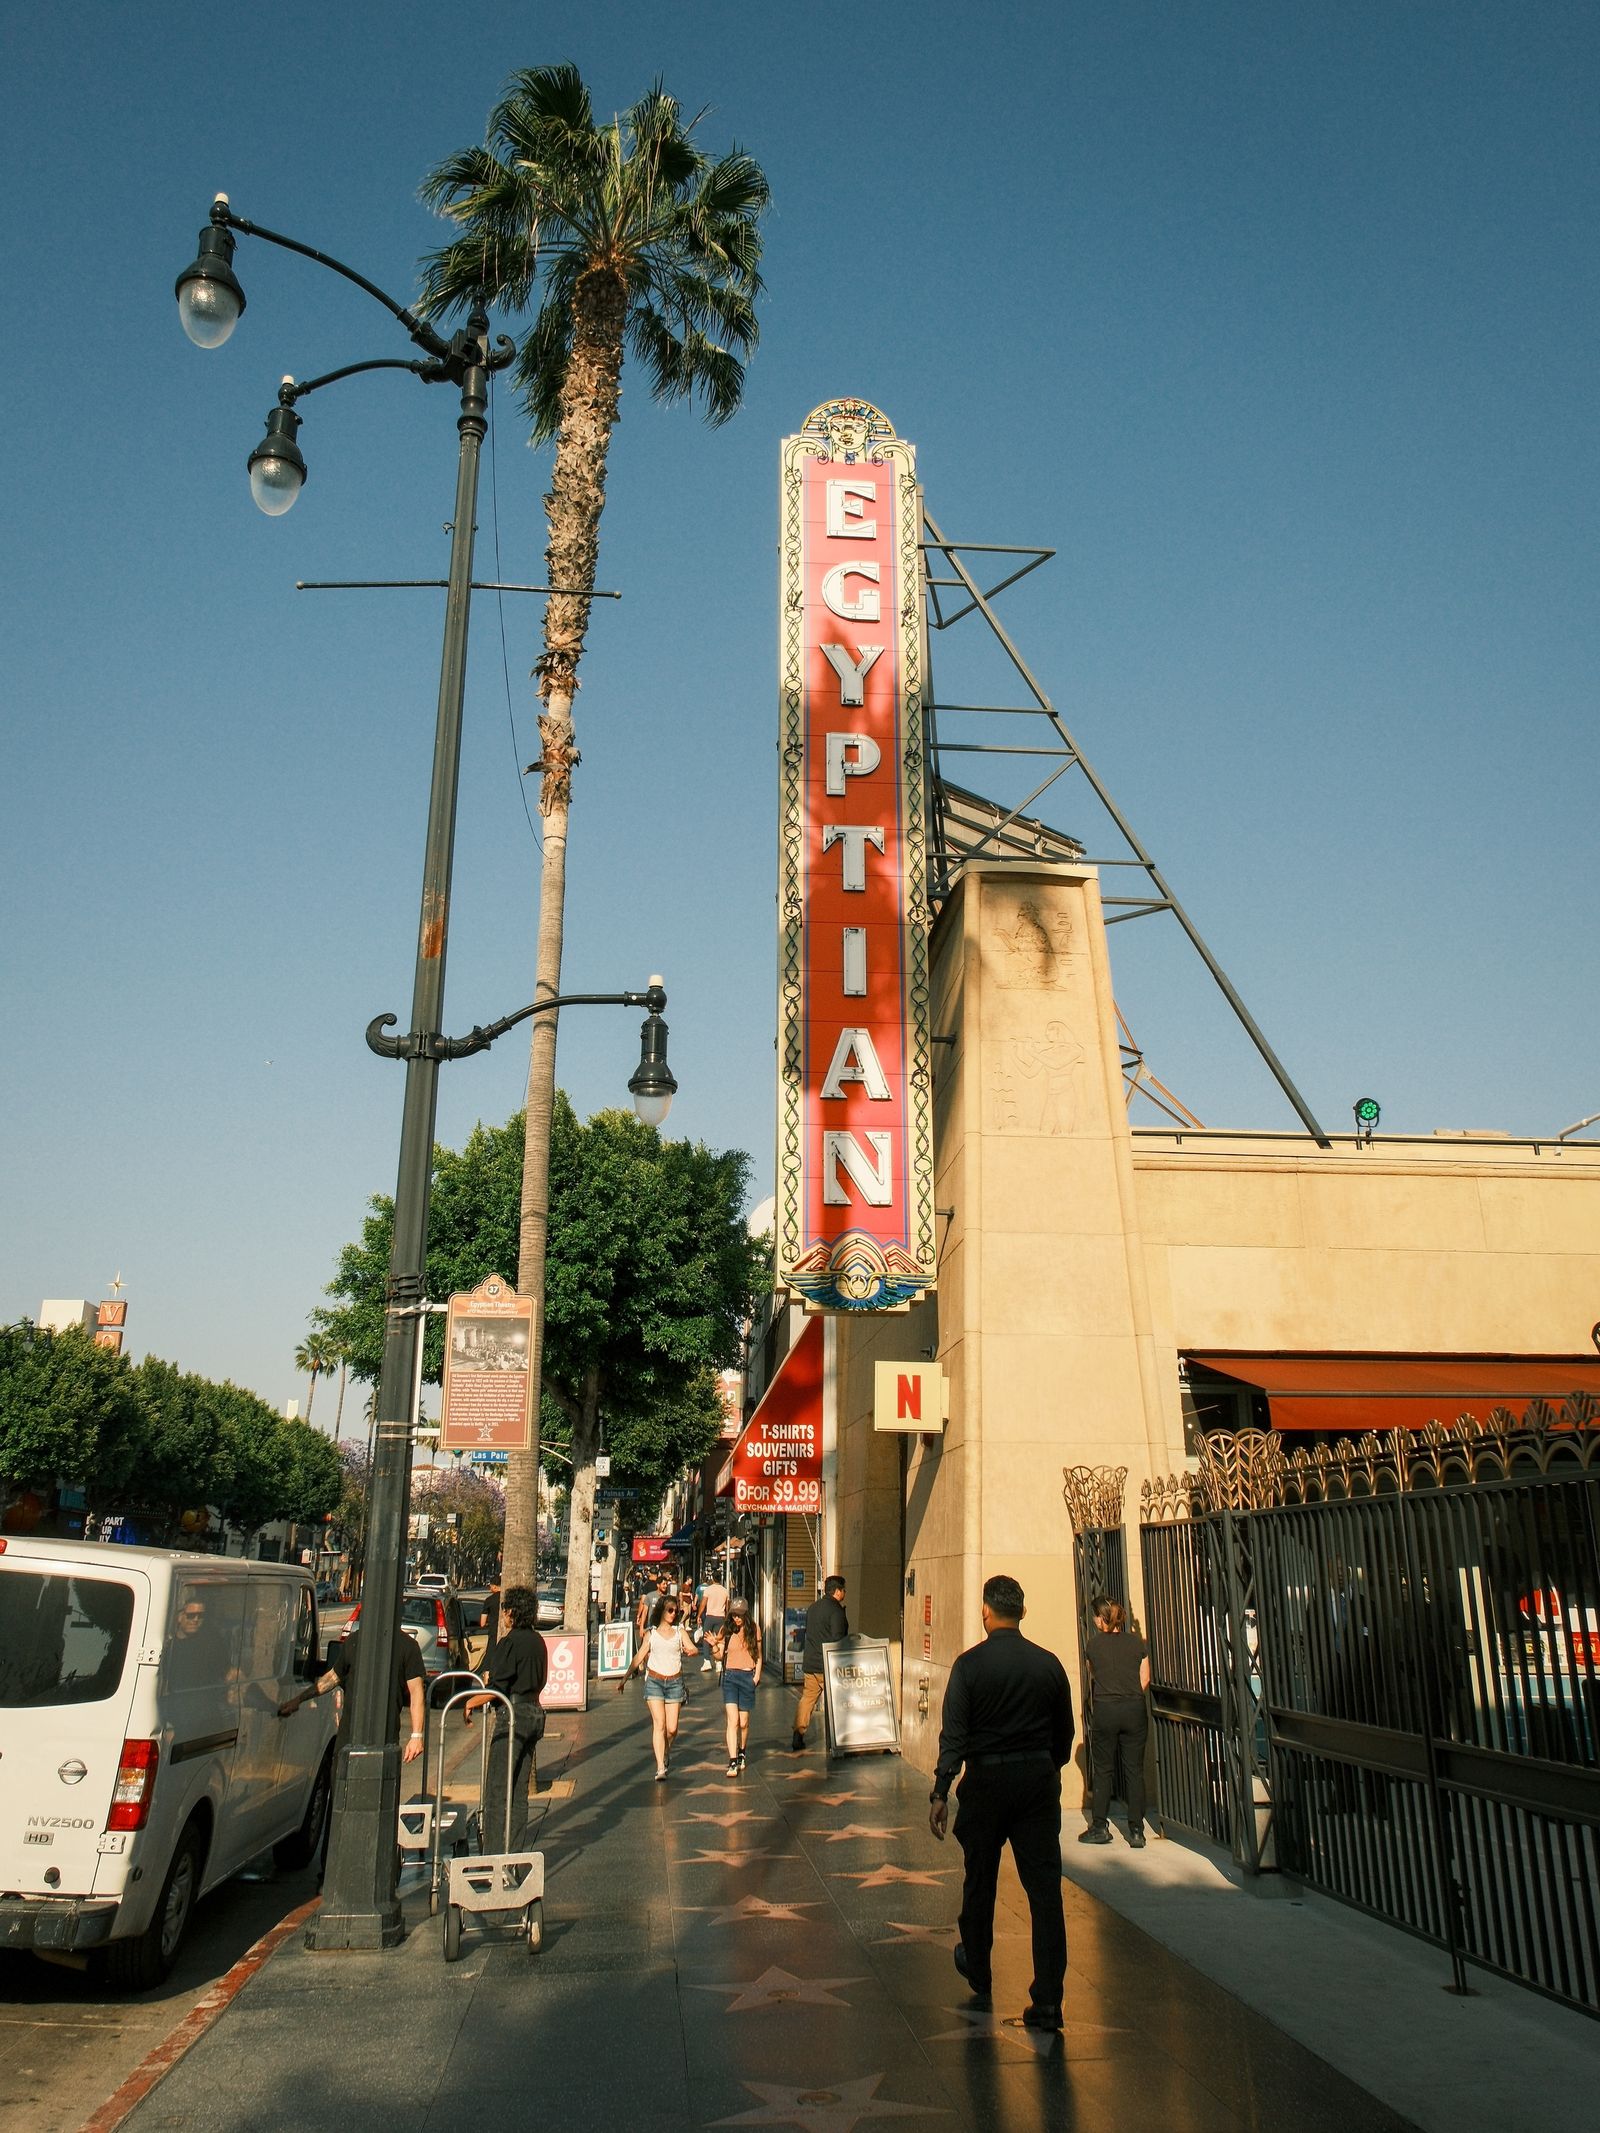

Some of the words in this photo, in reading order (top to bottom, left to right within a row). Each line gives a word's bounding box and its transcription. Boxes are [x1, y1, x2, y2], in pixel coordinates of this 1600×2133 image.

[819, 479, 893, 1206] EGYPTIAN
[489, 1286, 499, 1294] 37
[897, 1374, 922, 1420] N
[761, 1424, 815, 1440] T-SHIRTS
[472, 1451, 487, 1459] Las
[746, 1442, 815, 1458] SOUVENIRS
[763, 1460, 798, 1476] GIFTS
[773, 1478, 819, 1504] $9.99
[737, 1503, 776, 1511] KEYCHAIN
[785, 1504, 818, 1512] MAGNET
[104, 1516, 125, 1526] PART
[551, 1640, 574, 1669] 6
[549, 1669, 575, 1681] FOR
[836, 1663, 881, 1678] NETFLIX
[543, 1682, 580, 1695] $9.99
[842, 1676, 878, 1690] STORE
[27, 1815, 95, 1830] NV2500
[28, 1833, 50, 1844] HD
